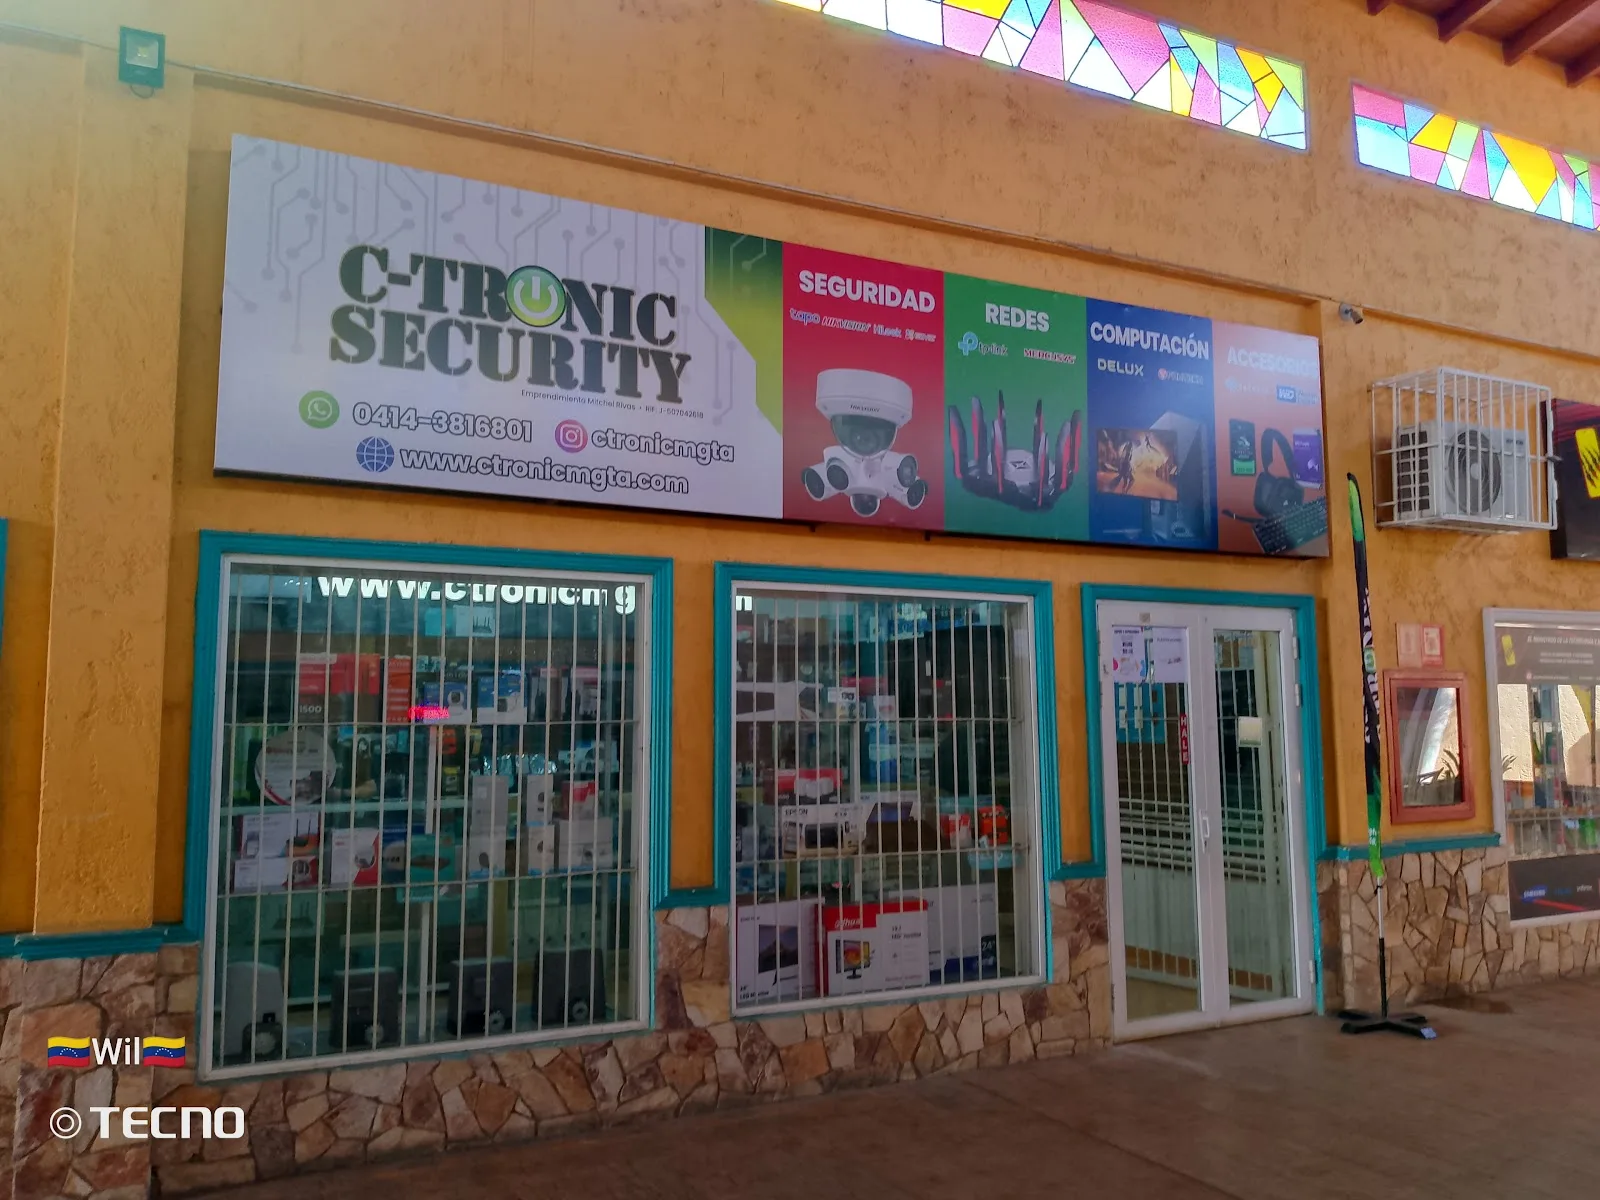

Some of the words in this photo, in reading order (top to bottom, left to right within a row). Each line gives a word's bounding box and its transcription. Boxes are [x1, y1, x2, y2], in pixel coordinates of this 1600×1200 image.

[799, 269, 936, 314] SEGURIDAD
[985, 302, 1050, 333] REDES
[329, 304, 692, 404] SECURITY
[1090, 321, 1210, 360] COMPUTACIÓN
[1097, 358, 1144, 377] DELUX
[521, 389, 586, 405] Emprendimiento
[616, 400, 636, 411] Rivas
[352, 401, 533, 443] 0414-3816801
[591, 428, 735, 466] ctronicmgta
[399, 448, 689, 493] www.ctronicmgta.com
